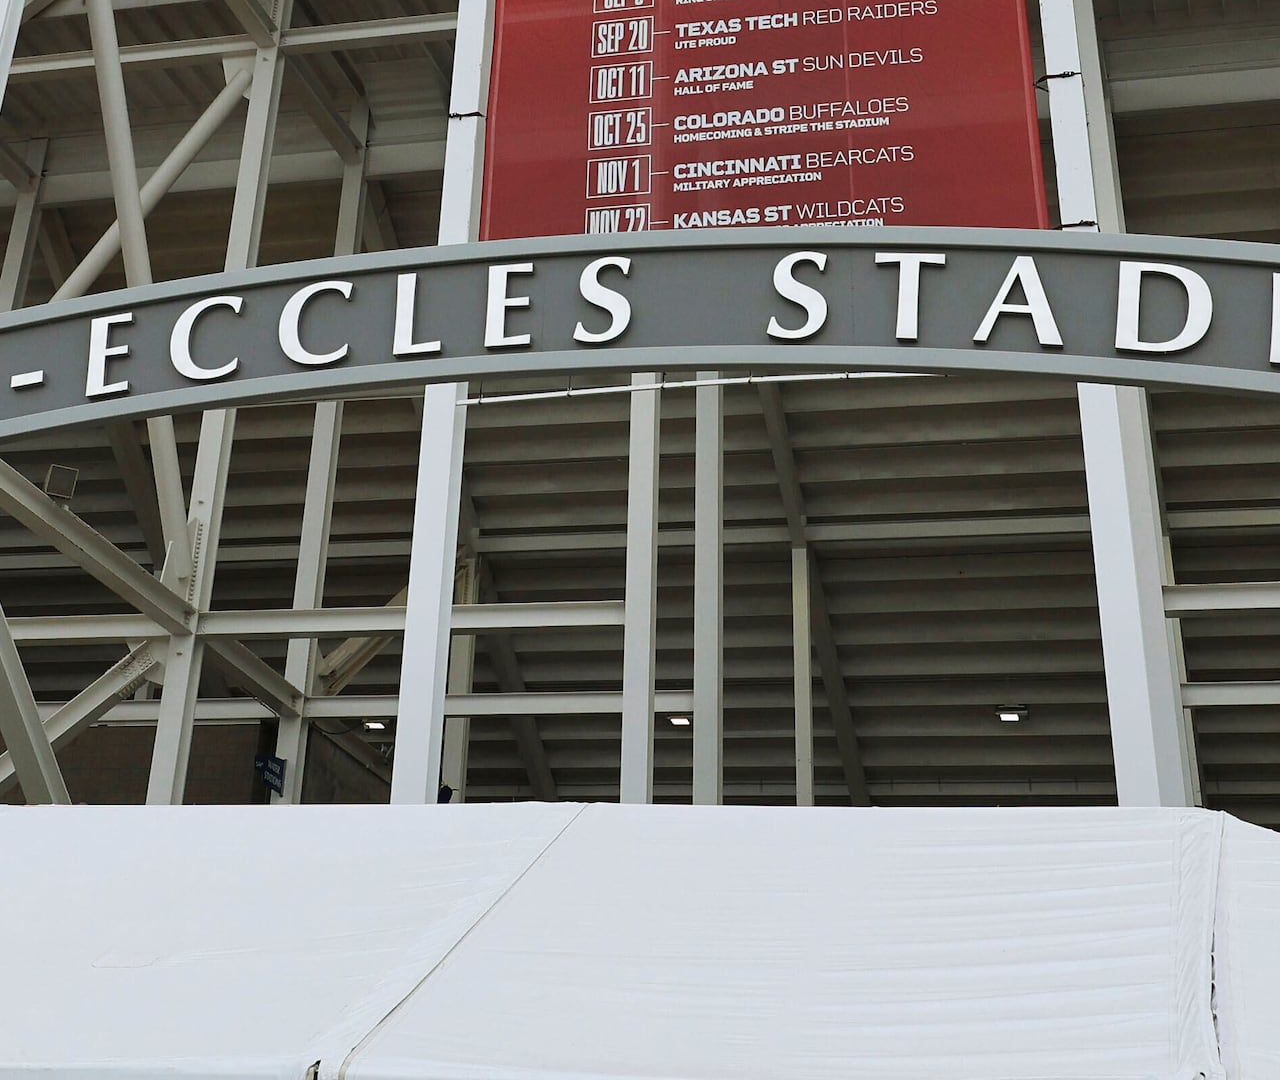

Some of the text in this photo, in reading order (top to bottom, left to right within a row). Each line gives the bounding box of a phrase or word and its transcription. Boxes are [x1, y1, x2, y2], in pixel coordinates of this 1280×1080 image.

[597, 17, 650, 56] SEP 20
[675, 0, 938, 39] TEXAS TECH RED RAIDERS
[674, 34, 737, 50] UTE PROUD
[596, 63, 647, 101] OCT 11
[674, 47, 923, 85] ARIZONA ST SUN DEVILS
[673, 78, 754, 96] HALL OF FAME
[592, 108, 648, 148] OCT 25
[673, 114, 890, 144] HOMECOMING & STRIPE THE STADIUM
[674, 96, 909, 132] COLORADO BUFFALOES
[596, 157, 640, 196] NOV 1
[673, 145, 914, 180] CINCINNATI BEARCATS
[673, 170, 822, 192] MILITARY APPRECIATION
[589, 206, 646, 234] NOV 22
[673, 196, 905, 229] KANSAS ST WILDCATS
